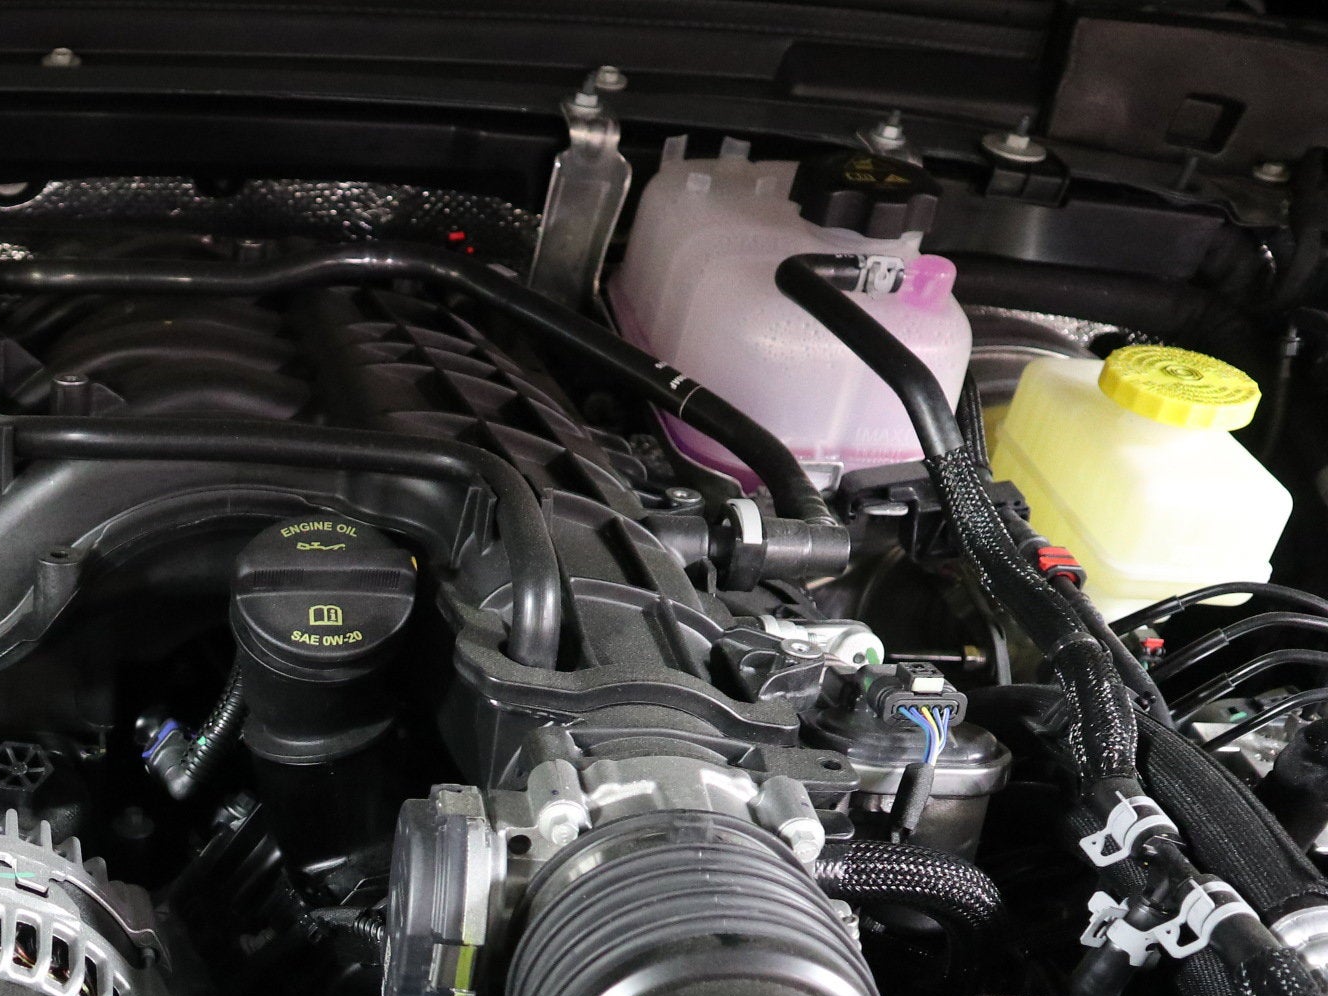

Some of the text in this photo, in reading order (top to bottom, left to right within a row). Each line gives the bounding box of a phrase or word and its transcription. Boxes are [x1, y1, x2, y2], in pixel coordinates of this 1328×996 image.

[280, 521, 358, 538] ENGINE OIL
[290, 630, 363, 646] SAE 0W-20
